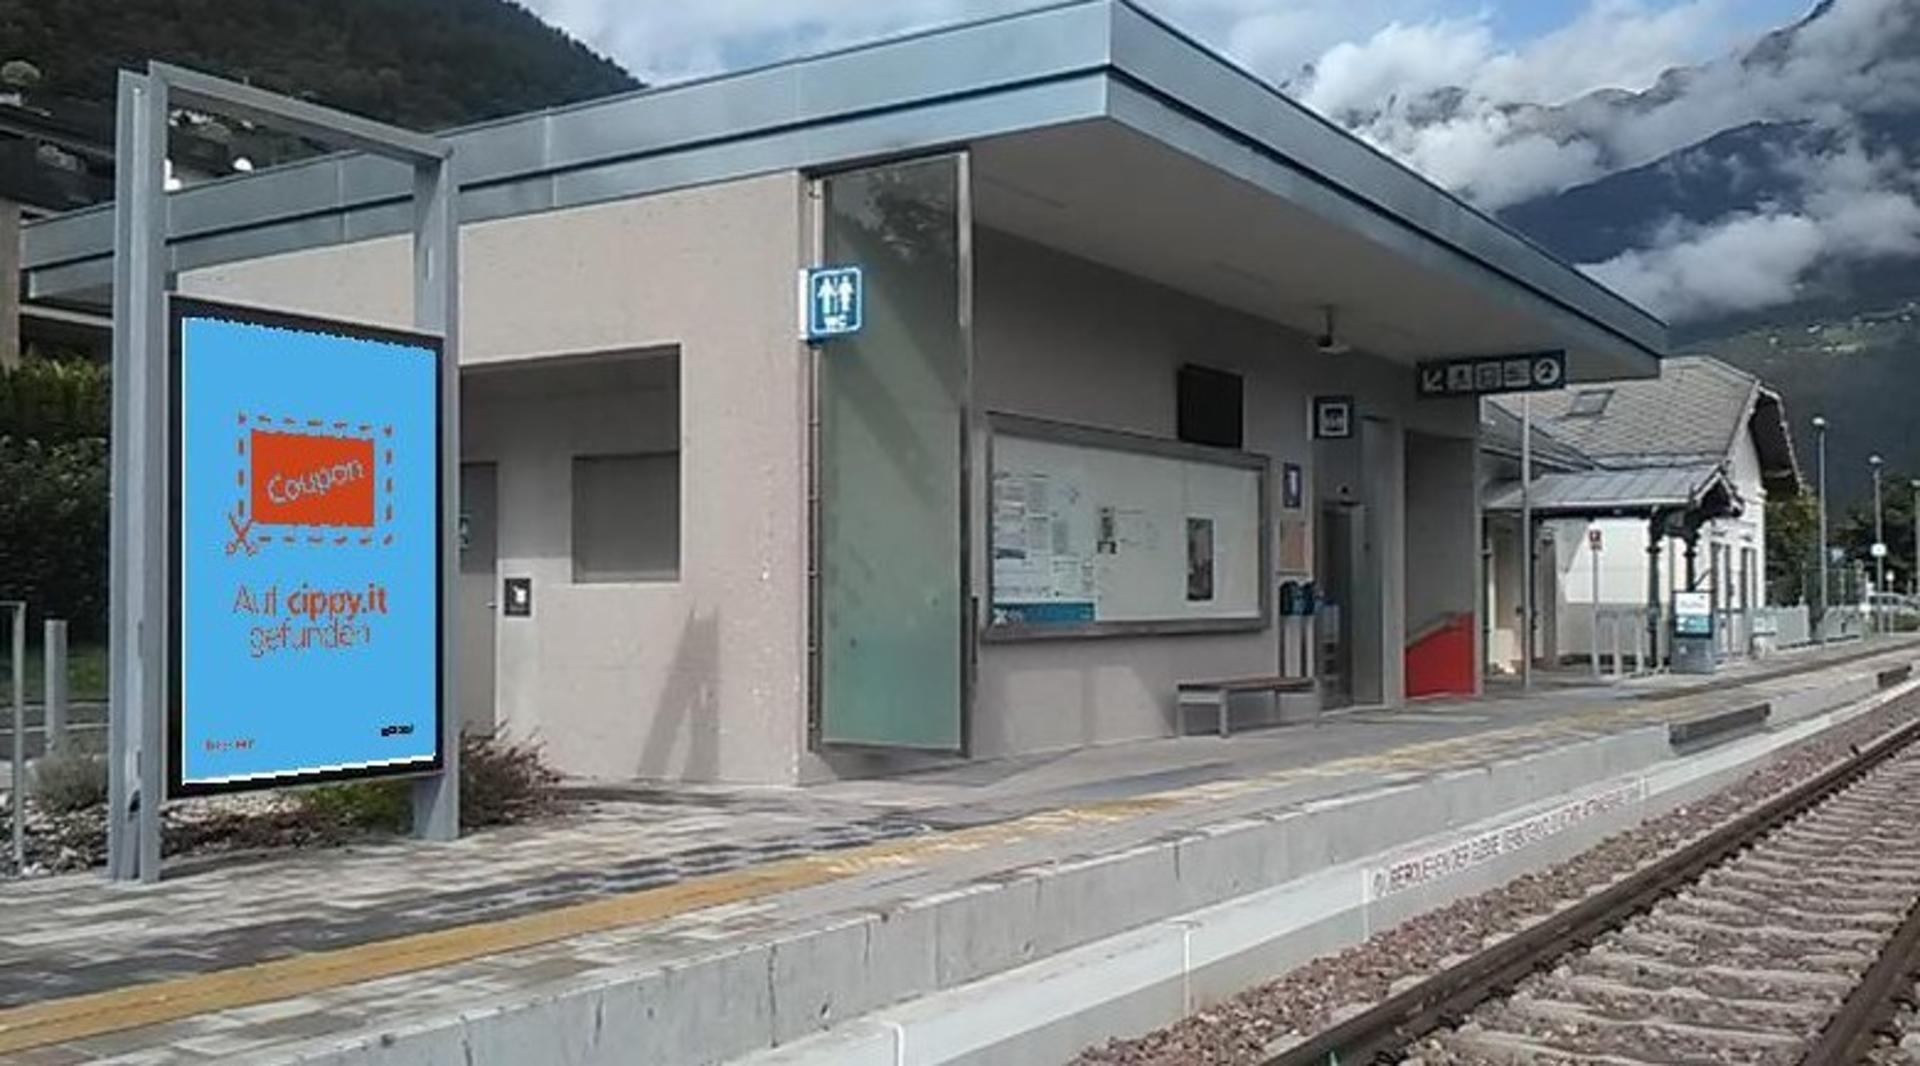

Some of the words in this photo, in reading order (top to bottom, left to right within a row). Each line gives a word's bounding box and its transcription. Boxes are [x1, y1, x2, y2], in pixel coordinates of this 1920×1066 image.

[267, 459, 365, 504] Coupon
[233, 583, 277, 617] Auf
[286, 582, 388, 622] cippy.it
[250, 616, 371, 658] gefunden
